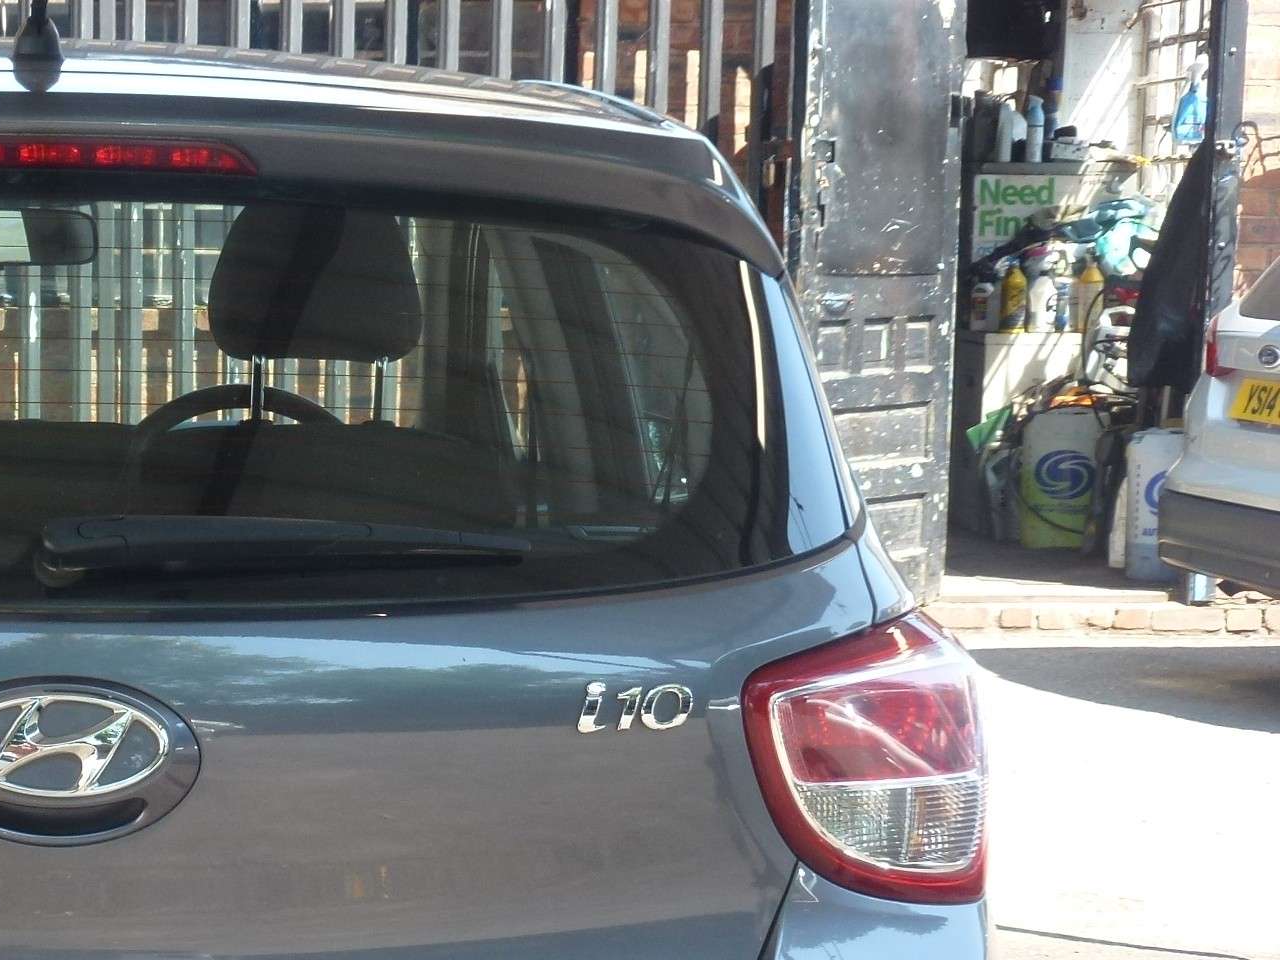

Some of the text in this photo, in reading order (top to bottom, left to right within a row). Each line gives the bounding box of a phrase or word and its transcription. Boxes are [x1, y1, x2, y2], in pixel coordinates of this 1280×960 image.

[980, 178, 1055, 205] Need
[979, 208, 1032, 236] Fin
[576, 681, 694, 734] i10
